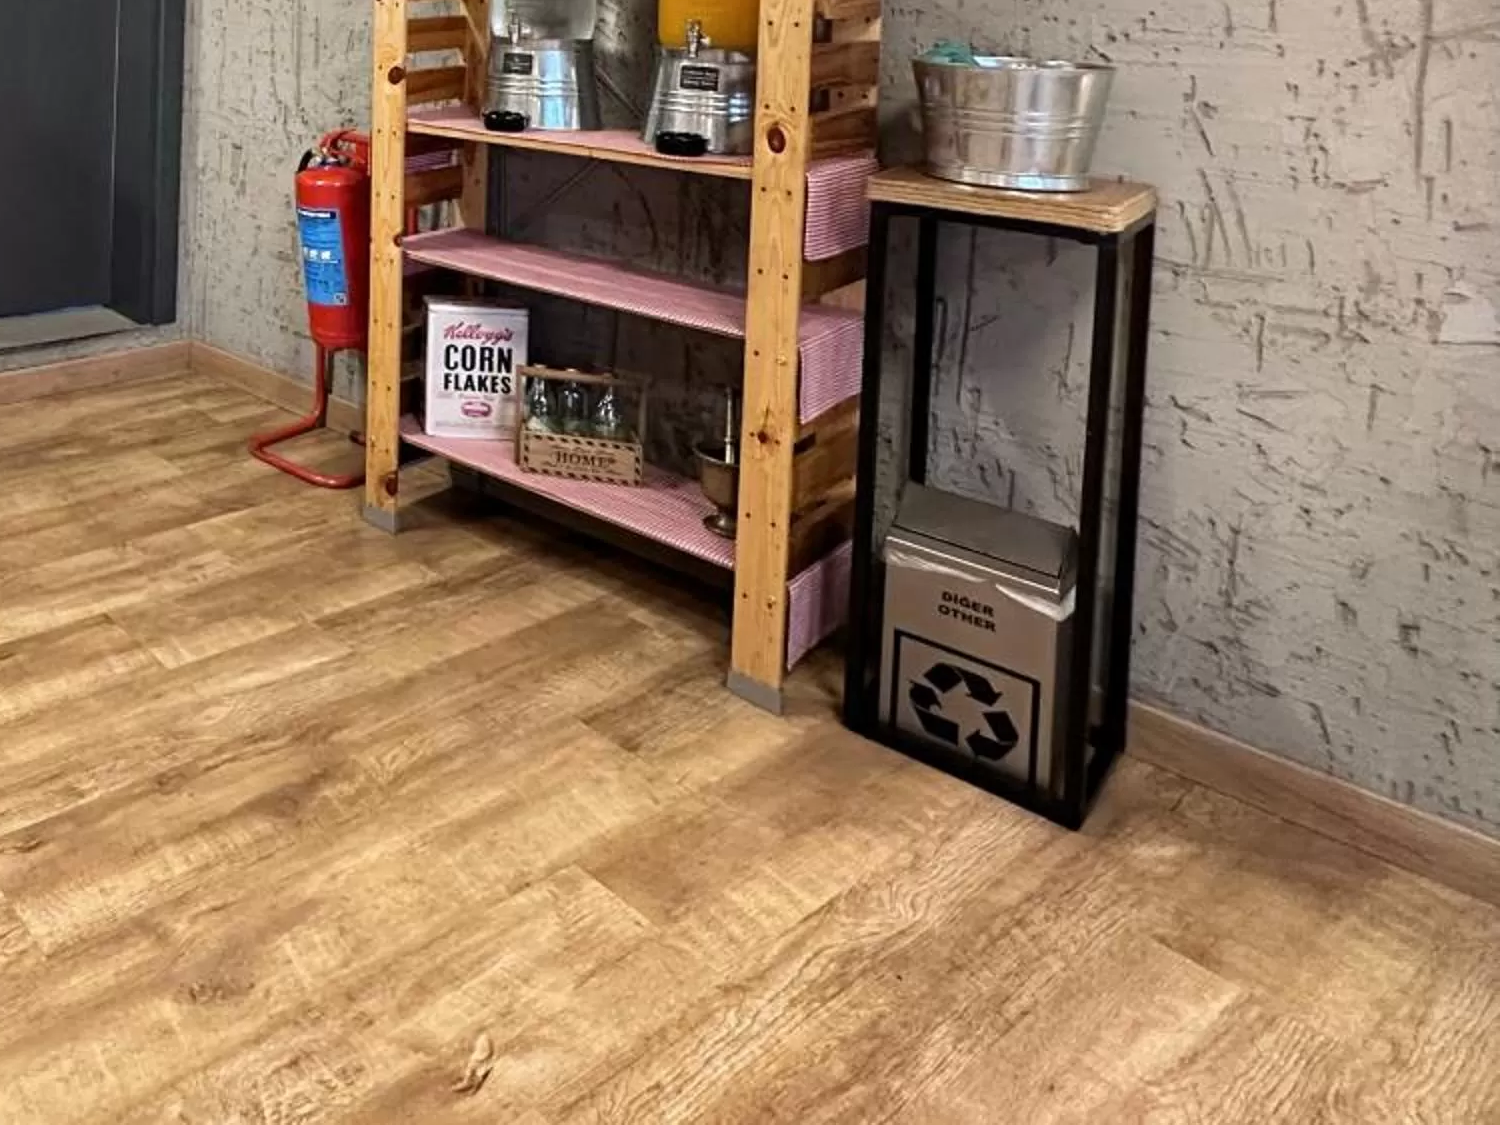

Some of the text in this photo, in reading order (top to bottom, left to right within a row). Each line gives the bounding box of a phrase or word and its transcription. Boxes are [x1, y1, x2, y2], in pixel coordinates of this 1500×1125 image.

[444, 321, 514, 346] Kellogg's
[444, 344, 513, 374] CORN
[444, 373, 512, 394] FLAKES
[937, 604, 997, 632] OTHER
